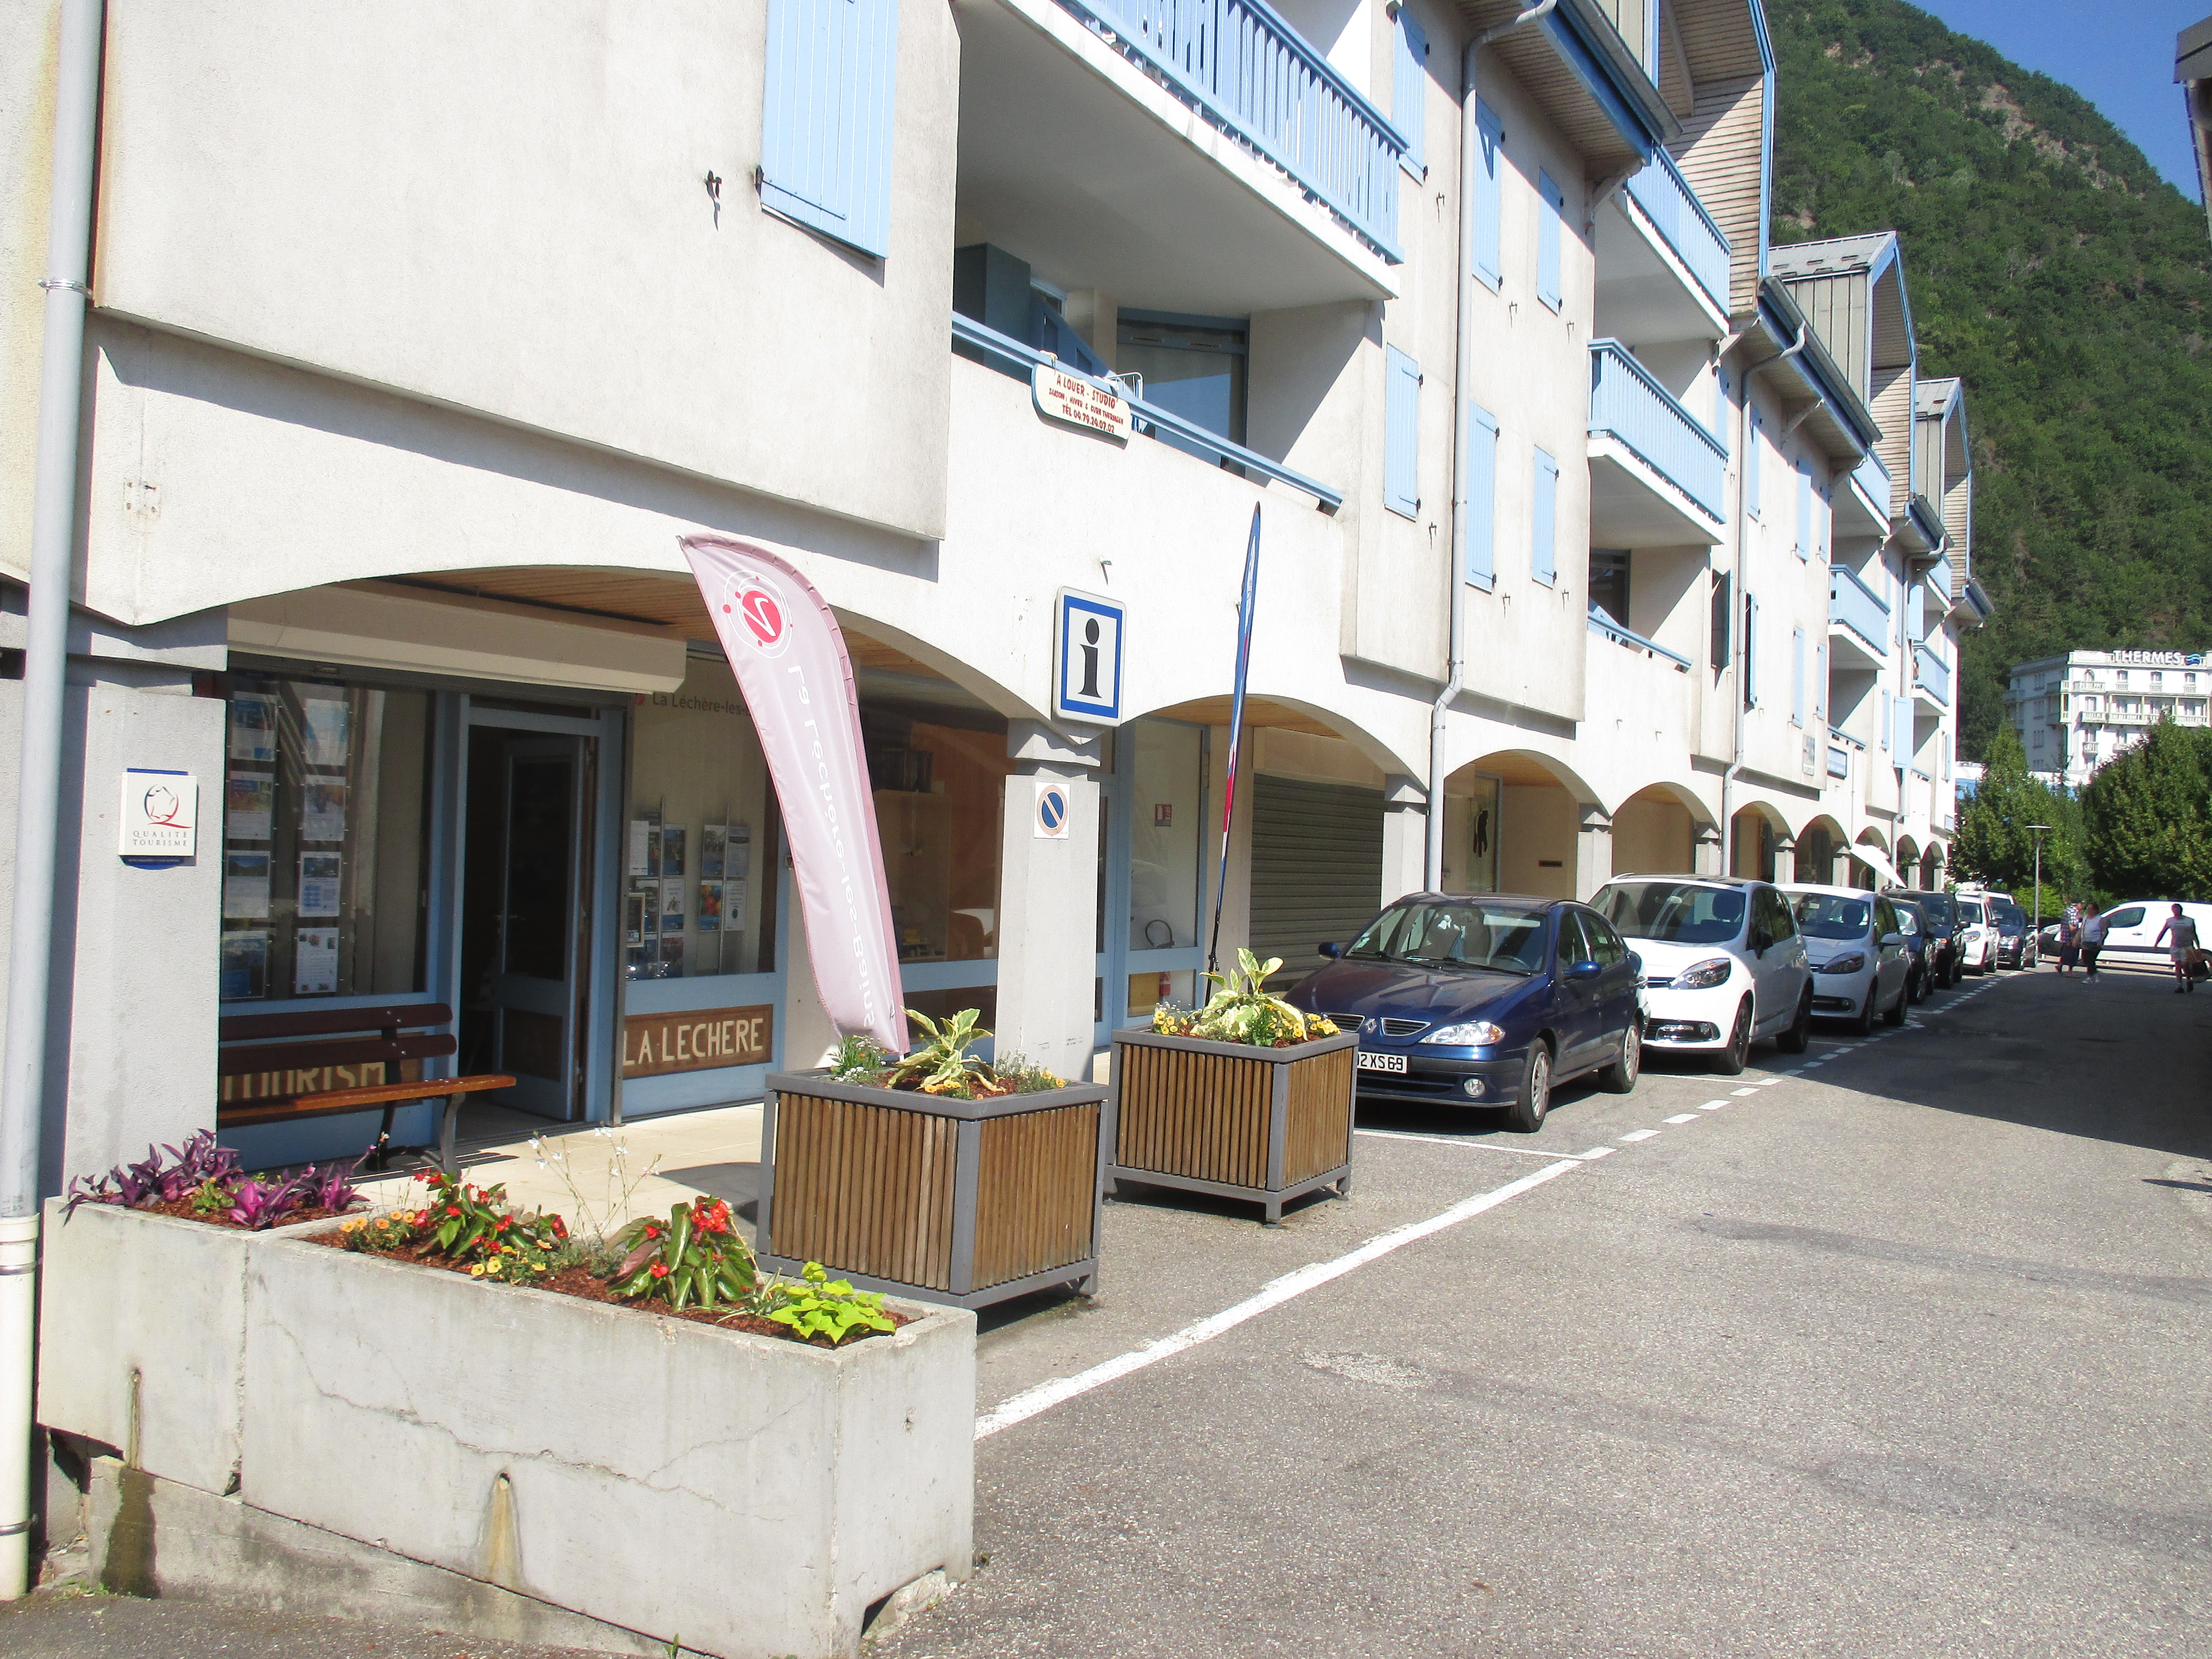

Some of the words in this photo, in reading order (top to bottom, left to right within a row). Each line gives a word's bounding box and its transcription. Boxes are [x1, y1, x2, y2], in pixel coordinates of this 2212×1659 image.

[1057, 373, 1061, 386] A
[1063, 376, 1085, 397] LOUER
[1092, 389, 1115, 409] STUDIO
[1070, 397, 1083, 409] HIVER
[1091, 405, 1101, 416] CURE
[1103, 410, 1124, 425] THERMALE
[2113, 650, 2181, 664] THERMES
[653, 693, 667, 706] La
[623, 1030, 653, 1066] LA
[662, 1018, 763, 1062] LECHERE
